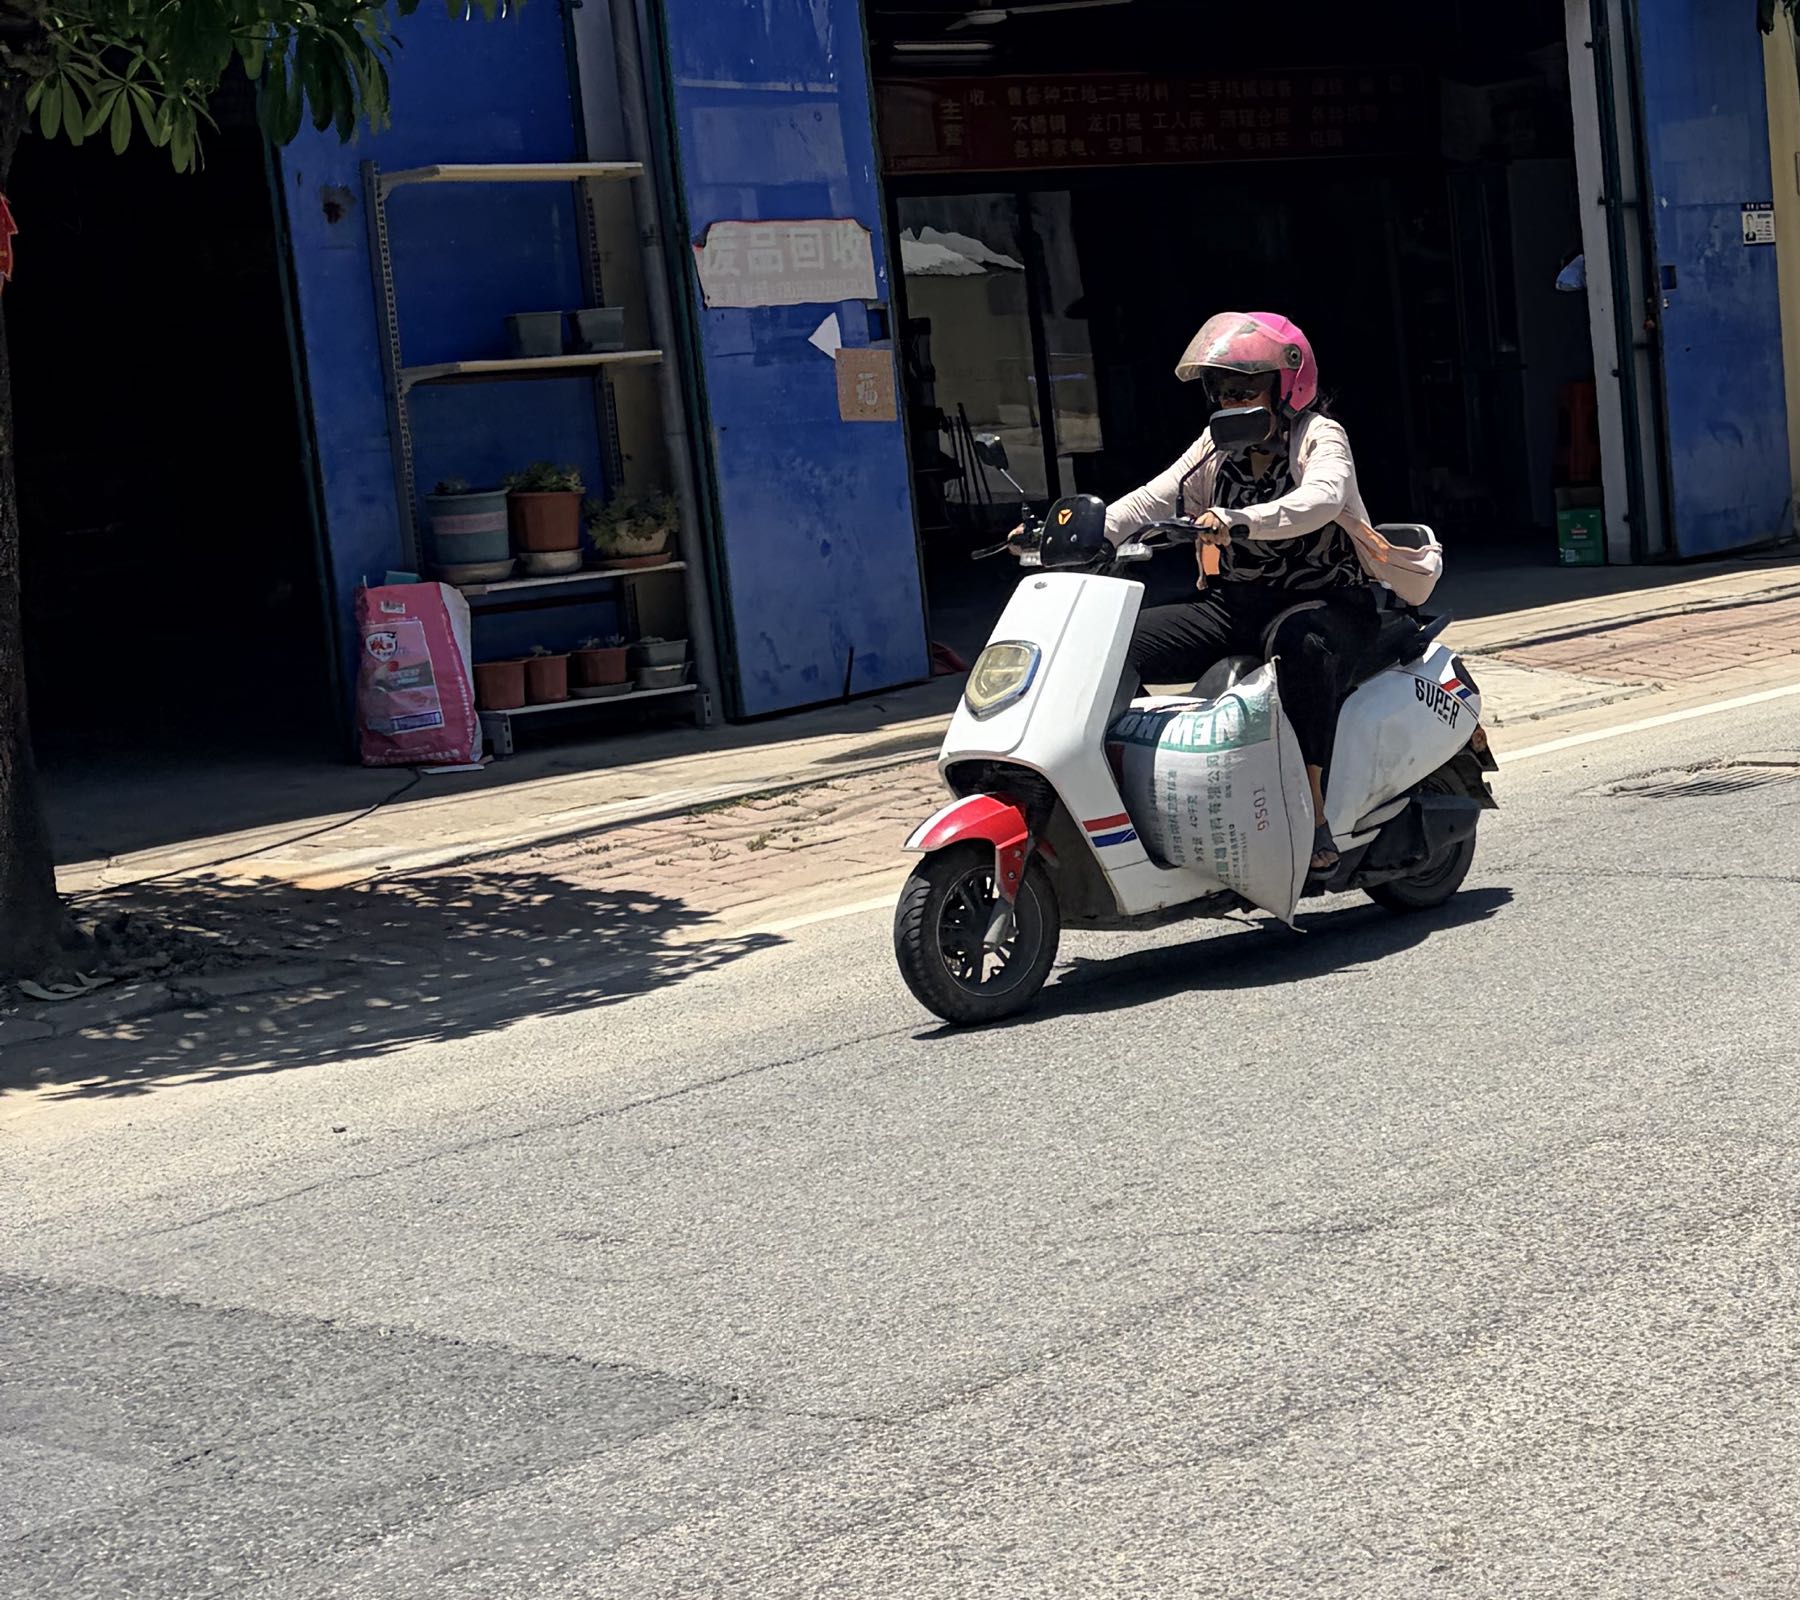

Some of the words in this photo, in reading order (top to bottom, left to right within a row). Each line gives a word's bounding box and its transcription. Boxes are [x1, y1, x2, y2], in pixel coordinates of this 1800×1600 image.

[1151, 109, 1206, 130] 工人床
[702, 222, 868, 278] 废品回收
[1159, 703, 1240, 746] NEW
[1414, 677, 1461, 730] SUPER
[1252, 785, 1271, 832] 9501
